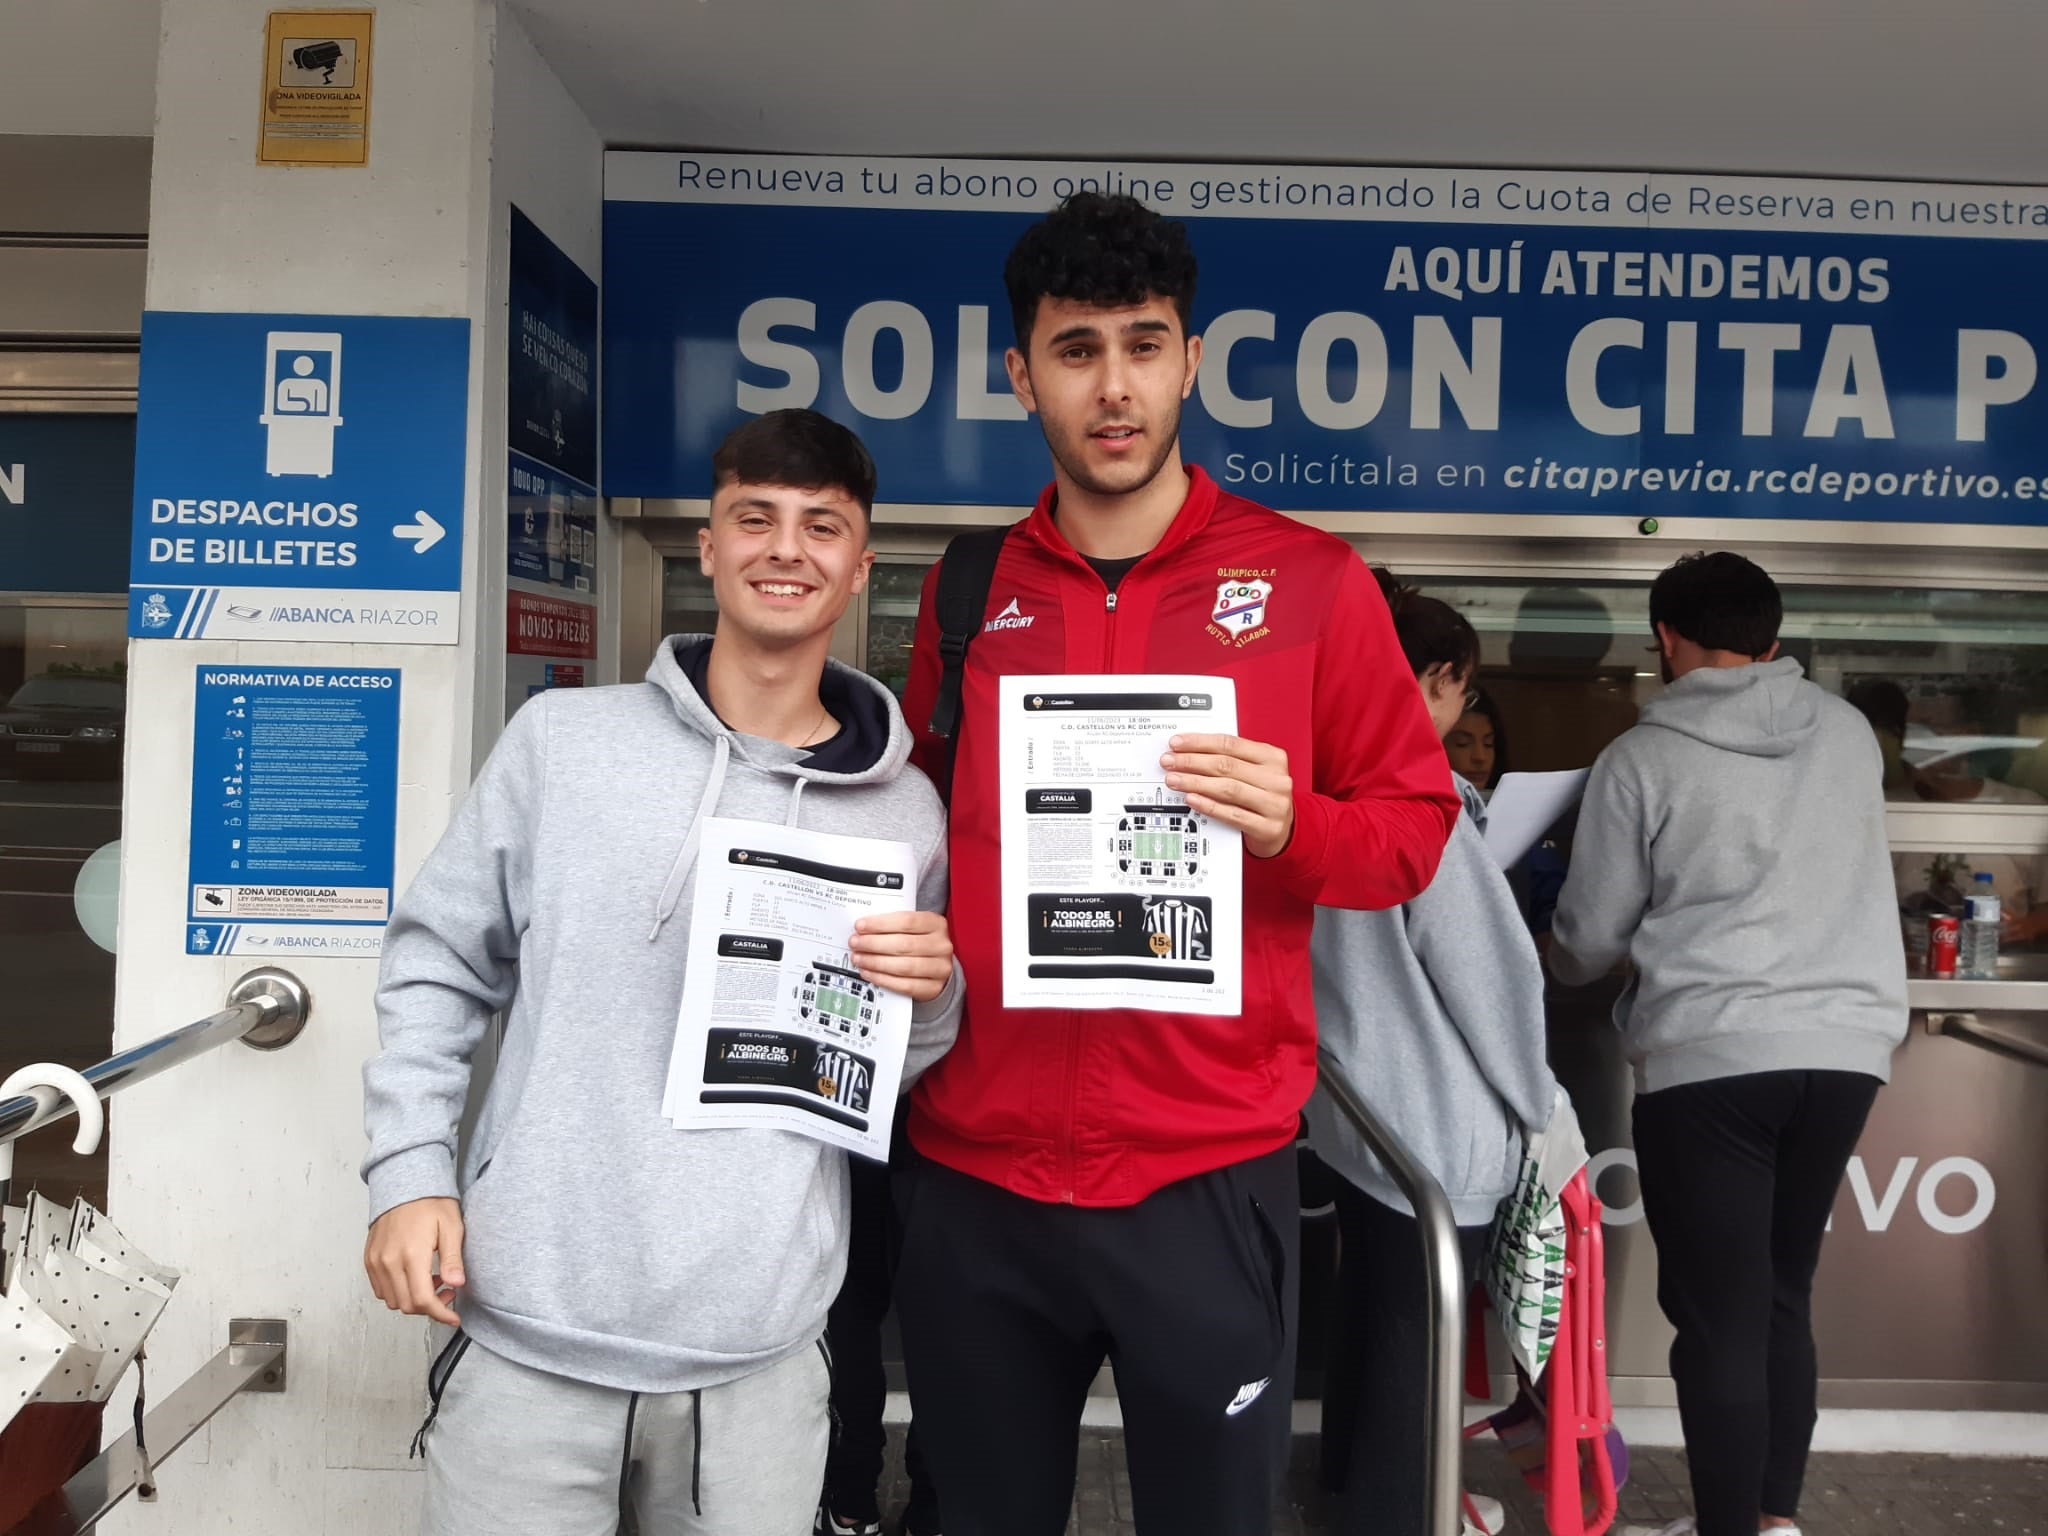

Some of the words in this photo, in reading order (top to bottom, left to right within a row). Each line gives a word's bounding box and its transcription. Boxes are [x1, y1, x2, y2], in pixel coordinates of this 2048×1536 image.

[276, 92, 294, 100] ONA
[296, 92, 361, 100] VIDEOVIGILADA
[678, 160, 844, 193] Renueva
[860, 167, 898, 195] tu
[915, 166, 1037, 198] abono
[1053, 170, 1175, 201] online
[1190, 175, 1434, 209] gestionando
[1451, 179, 1481, 209] la
[1497, 181, 1610, 212] Cuota
[1626, 184, 1672, 215] de
[1689, 187, 1834, 219] Reserva
[1850, 198, 1894, 221] en
[1912, 199, 2048, 226] nuestra
[1384, 240, 1524, 301] AQUÍ
[1540, 250, 1890, 304] ATENDEMOS
[736, 297, 1028, 422] SOL
[1200, 307, 1502, 433] CON
[1565, 317, 1896, 439] CITA
[1955, 328, 2038, 442] P
[1224, 453, 1418, 486] Solicítala
[1436, 463, 1486, 487] en
[0, 464, 25, 504] N
[151, 498, 358, 528] DESPACHOS
[149, 537, 196, 564] DE
[204, 539, 358, 567] BILLETES
[360, 608, 439, 626] RIAZOR
[1242, 613, 1253, 625] R
[520, 613, 553, 639] NOVOS
[557, 619, 590, 643] PREZOS
[1205, 624, 1231, 646] RUTIS
[204, 673, 301, 688] NORMATIVA
[303, 675, 324, 688] DE
[328, 676, 393, 689] ACCESO
[238, 887, 265, 896] ZONA
[267, 888, 337, 897] VIDEOVIGILADA
[1050, 919, 1115, 928] ALBINEGRO
[1053, 911, 1093, 919] TODOS
[1095, 911, 1111, 919] DE
[330, 937, 382, 949] RIAZOR
[732, 940, 768, 949] CASTALIA
[727, 1051, 789, 1062] ALBINEGRO
[732, 1043, 769, 1054] TODOS
[772, 1046, 787, 1055] DE
